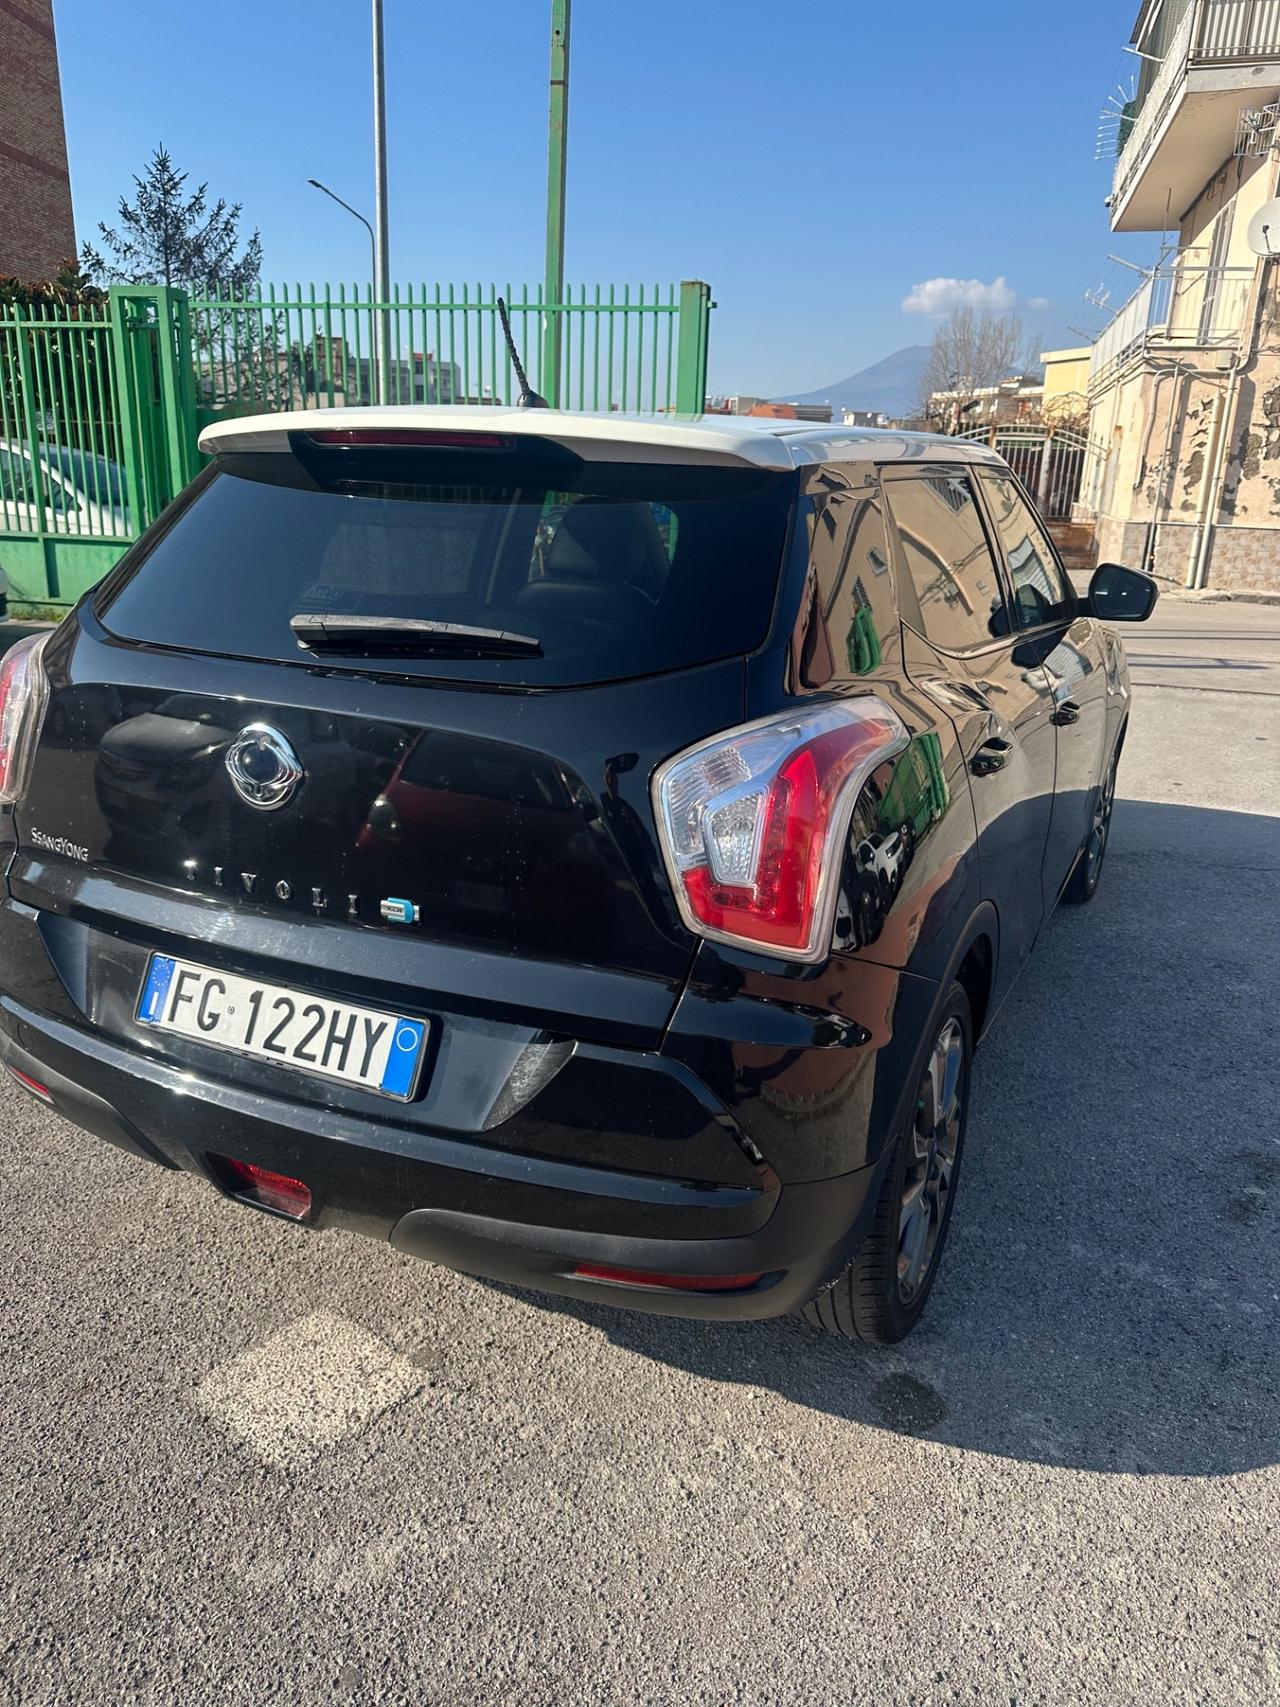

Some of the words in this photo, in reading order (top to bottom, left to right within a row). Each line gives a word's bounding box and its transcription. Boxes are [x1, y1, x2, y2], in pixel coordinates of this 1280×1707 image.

[183, 859, 358, 914] TIVOLI
[168, 969, 226, 1032] FG
[244, 990, 389, 1078] 122HY
